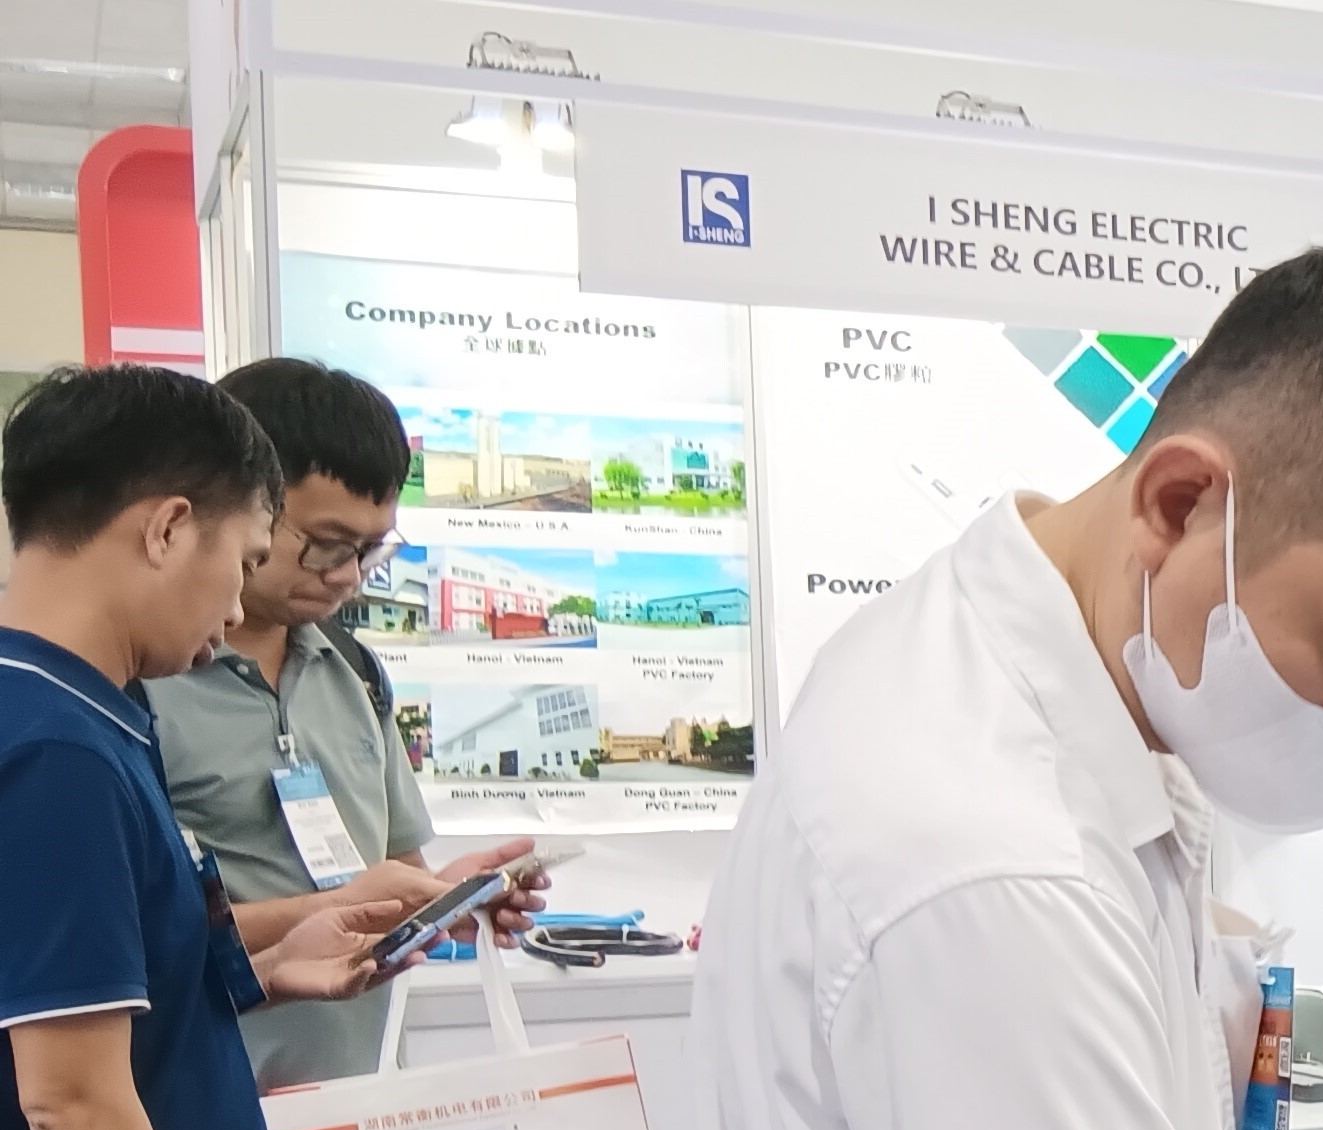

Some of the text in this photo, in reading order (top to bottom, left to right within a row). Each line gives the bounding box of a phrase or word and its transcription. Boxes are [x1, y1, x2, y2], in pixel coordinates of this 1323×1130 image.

[927, 196, 1248, 251] I SHENG ELECTRIC
[880, 234, 977, 271] WIRE
[990, 245, 1022, 272] &
[1032, 248, 1144, 284] CABLE
[1156, 261, 1219, 293] CO.,
[345, 300, 657, 341] Company Locations
[842, 327, 913, 352] PVC
[448, 518, 521, 531] New Mexico
[689, 527, 723, 538] China
[807, 574, 899, 595] Powe
[467, 653, 563, 665] Hanoi Vietnam
[632, 656, 724, 667] Hanoi Vietnam
[642, 670, 715, 681] PVC Factory
[538, 788, 586, 798] Vietnam
[624, 788, 737, 799] Dong China
[674, 802, 717, 813] Factory
